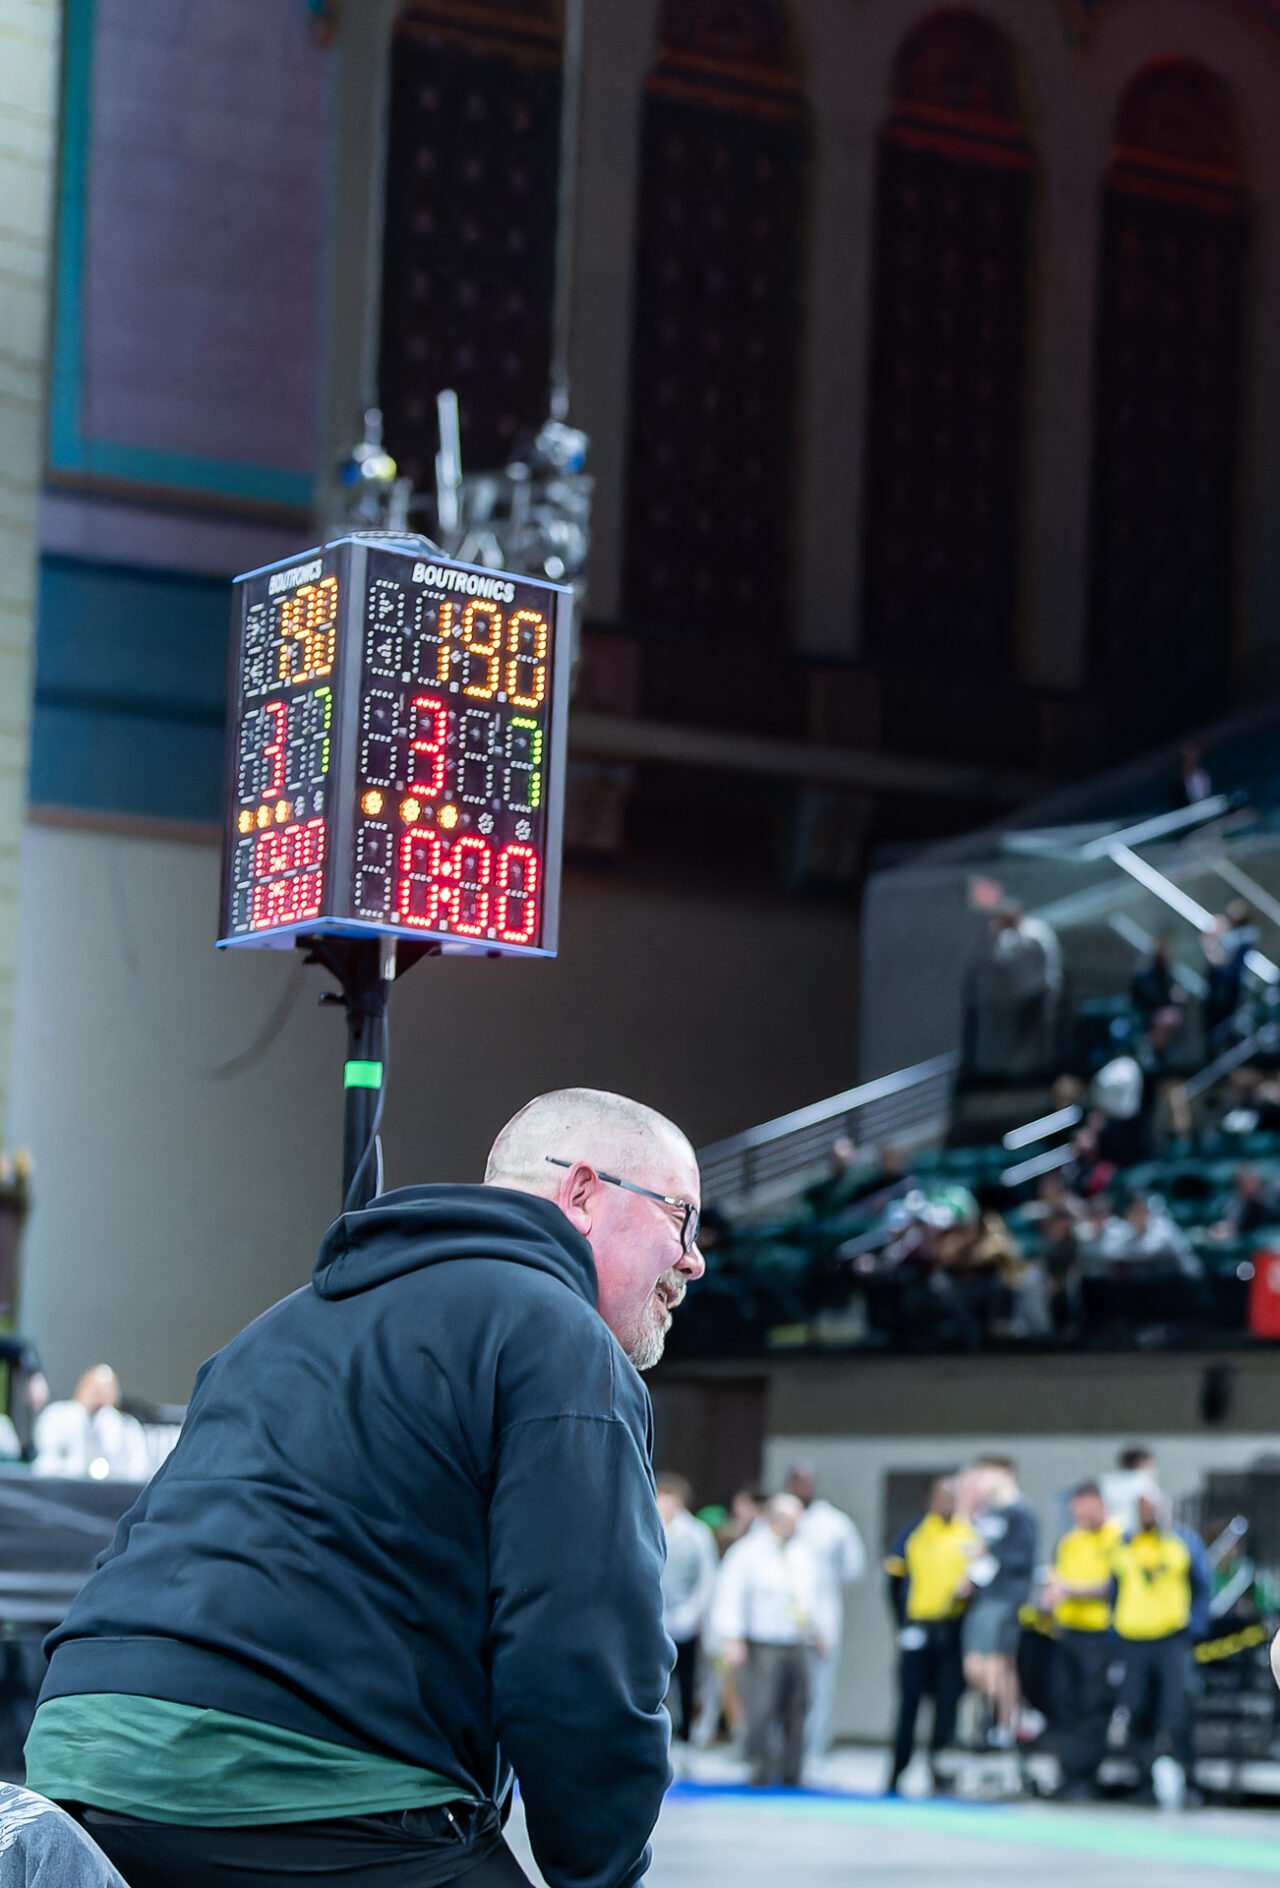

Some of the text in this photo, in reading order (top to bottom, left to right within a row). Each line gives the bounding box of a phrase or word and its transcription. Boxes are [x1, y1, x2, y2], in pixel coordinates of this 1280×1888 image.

[412, 562, 515, 603] BOUTRONICS
[438, 600, 547, 708] 190
[411, 697, 447, 797] 3
